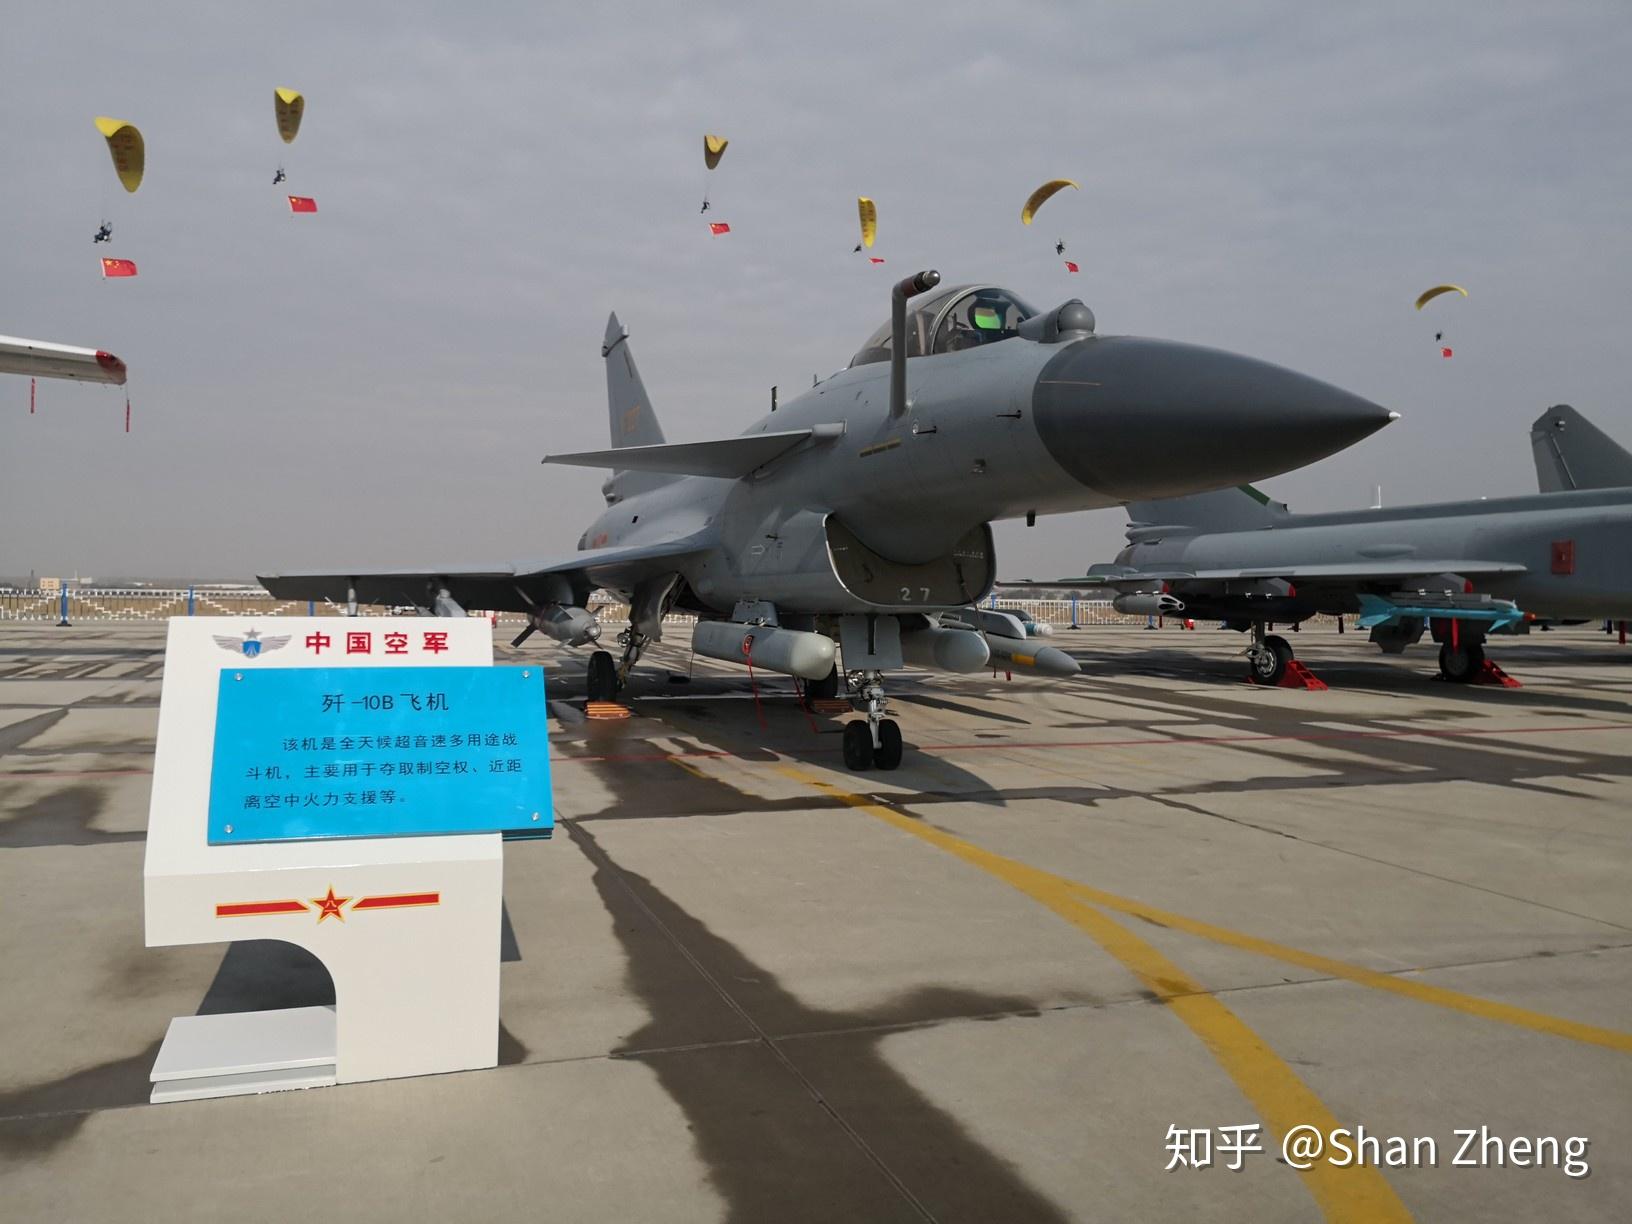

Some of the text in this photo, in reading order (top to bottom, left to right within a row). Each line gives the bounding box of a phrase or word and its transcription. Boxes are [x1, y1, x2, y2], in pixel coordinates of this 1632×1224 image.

[900, 587, 930, 601] 27
[305, 631, 449, 655] 中国空军
[283, 732, 518, 752] 该机是全天候超音速多用途战
